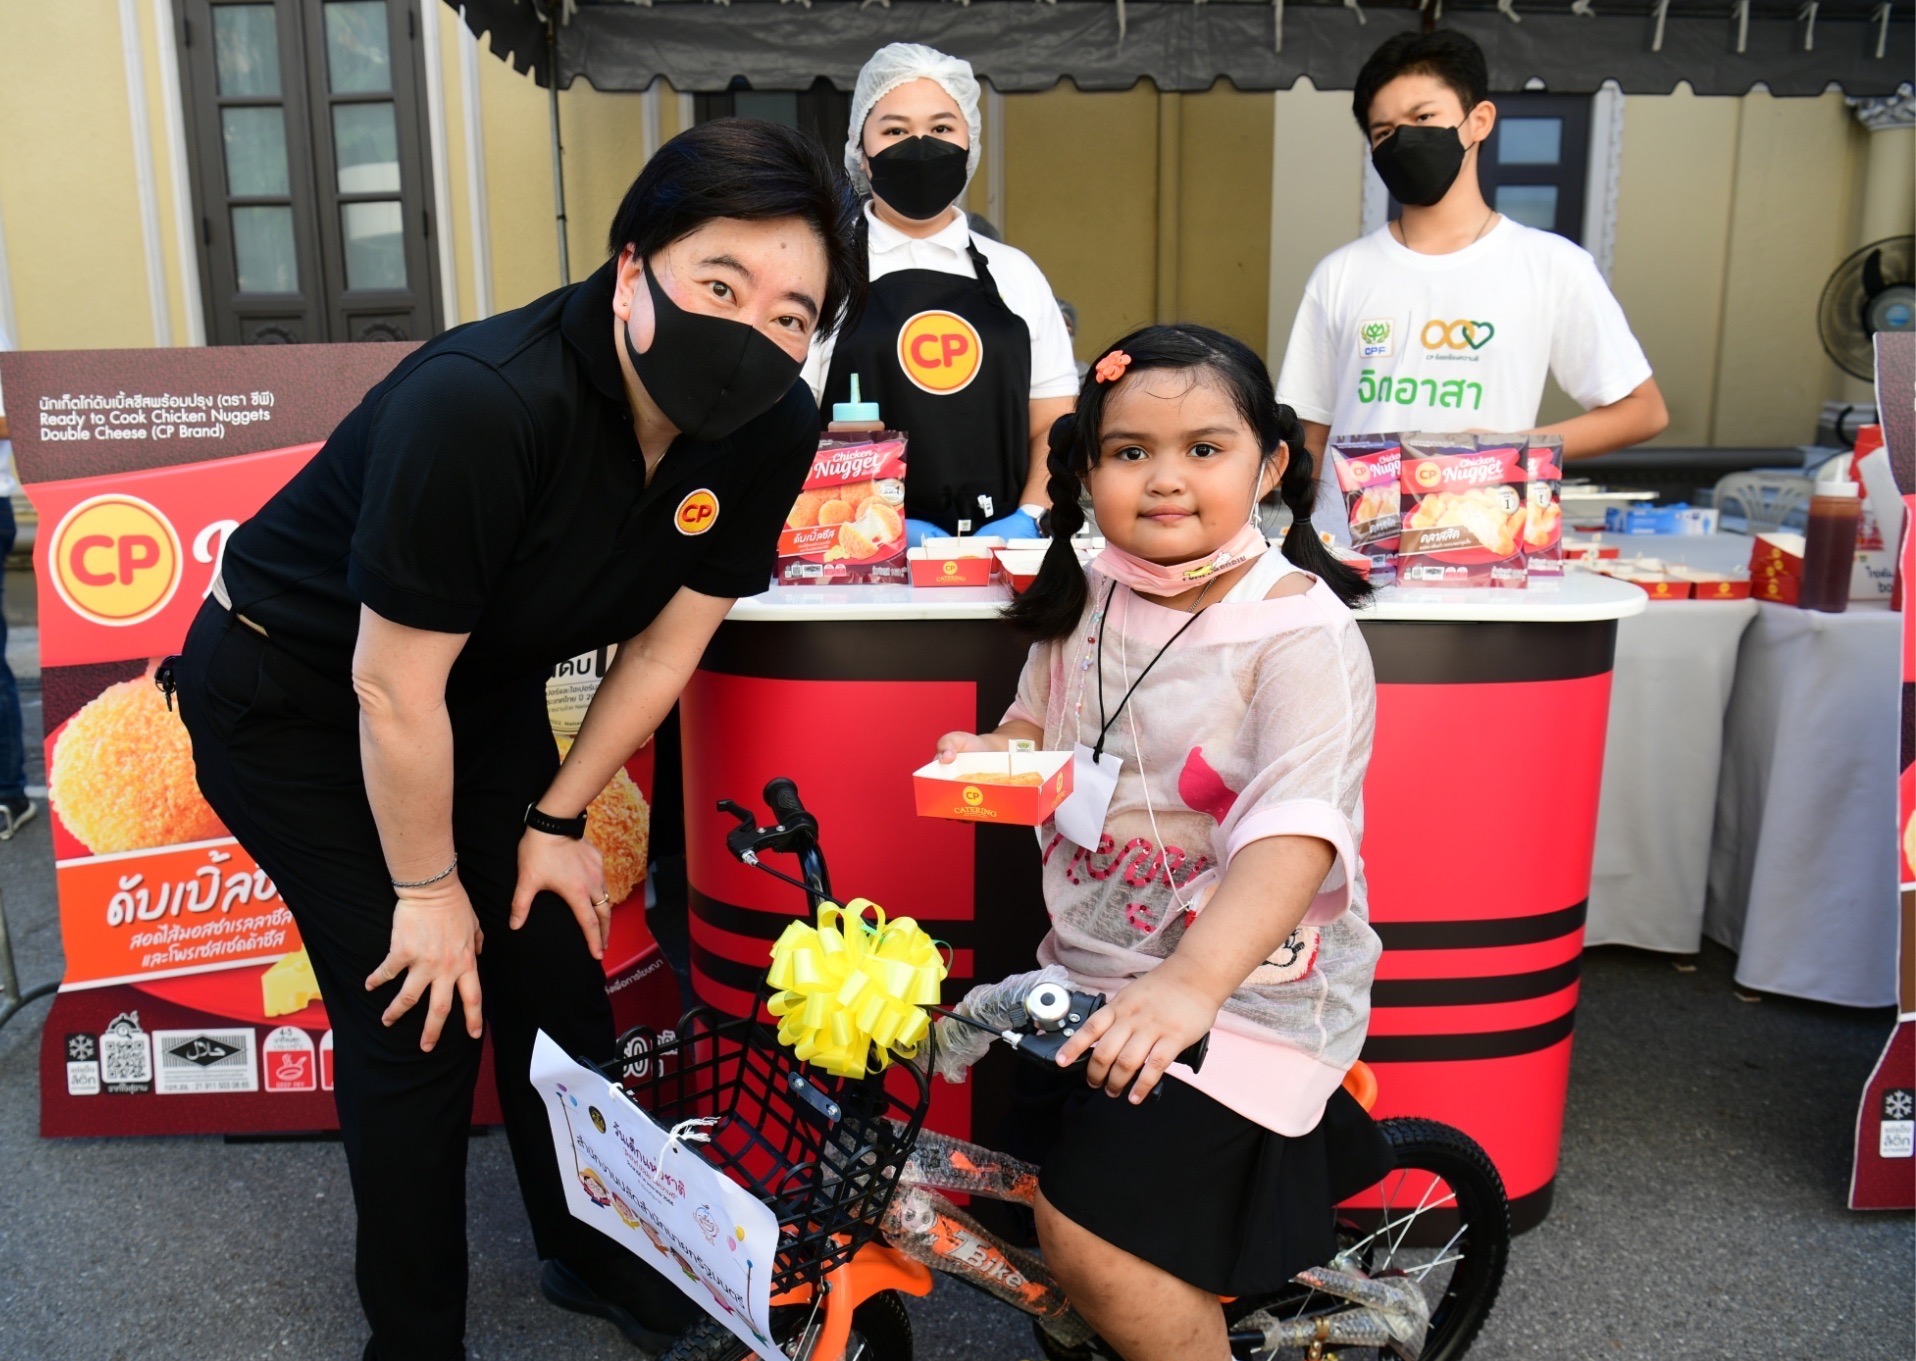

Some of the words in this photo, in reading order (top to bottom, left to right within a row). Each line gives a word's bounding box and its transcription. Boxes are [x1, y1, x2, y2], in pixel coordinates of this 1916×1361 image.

[911, 334, 968, 368] CP
[1364, 347, 1385, 355] CPF
[1358, 369, 1482, 410] จิตอาสา
[39, 412, 86, 430] Ready
[90, 412, 105, 425] to
[109, 410, 147, 424] Cook
[151, 409, 206, 423] Chicken
[210, 408, 271, 425] Nuggets
[40, 427, 91, 442] Double
[94, 426, 147, 440] Cheese
[151, 425, 175, 441] (CP
[179, 423, 226, 439] Brand)
[814, 453, 882, 479] Nugget
[832, 450, 873, 463] Chicken
[1460, 455, 1496, 468] Chicken
[1370, 460, 1401, 478] Nugg
[1420, 470, 1437, 479] CP
[1442, 460, 1504, 484] Nugget
[682, 503, 712, 523] CP
[69, 534, 160, 587] CP
[966, 791, 980, 800] CP
[954, 806, 997, 818] CATERING
